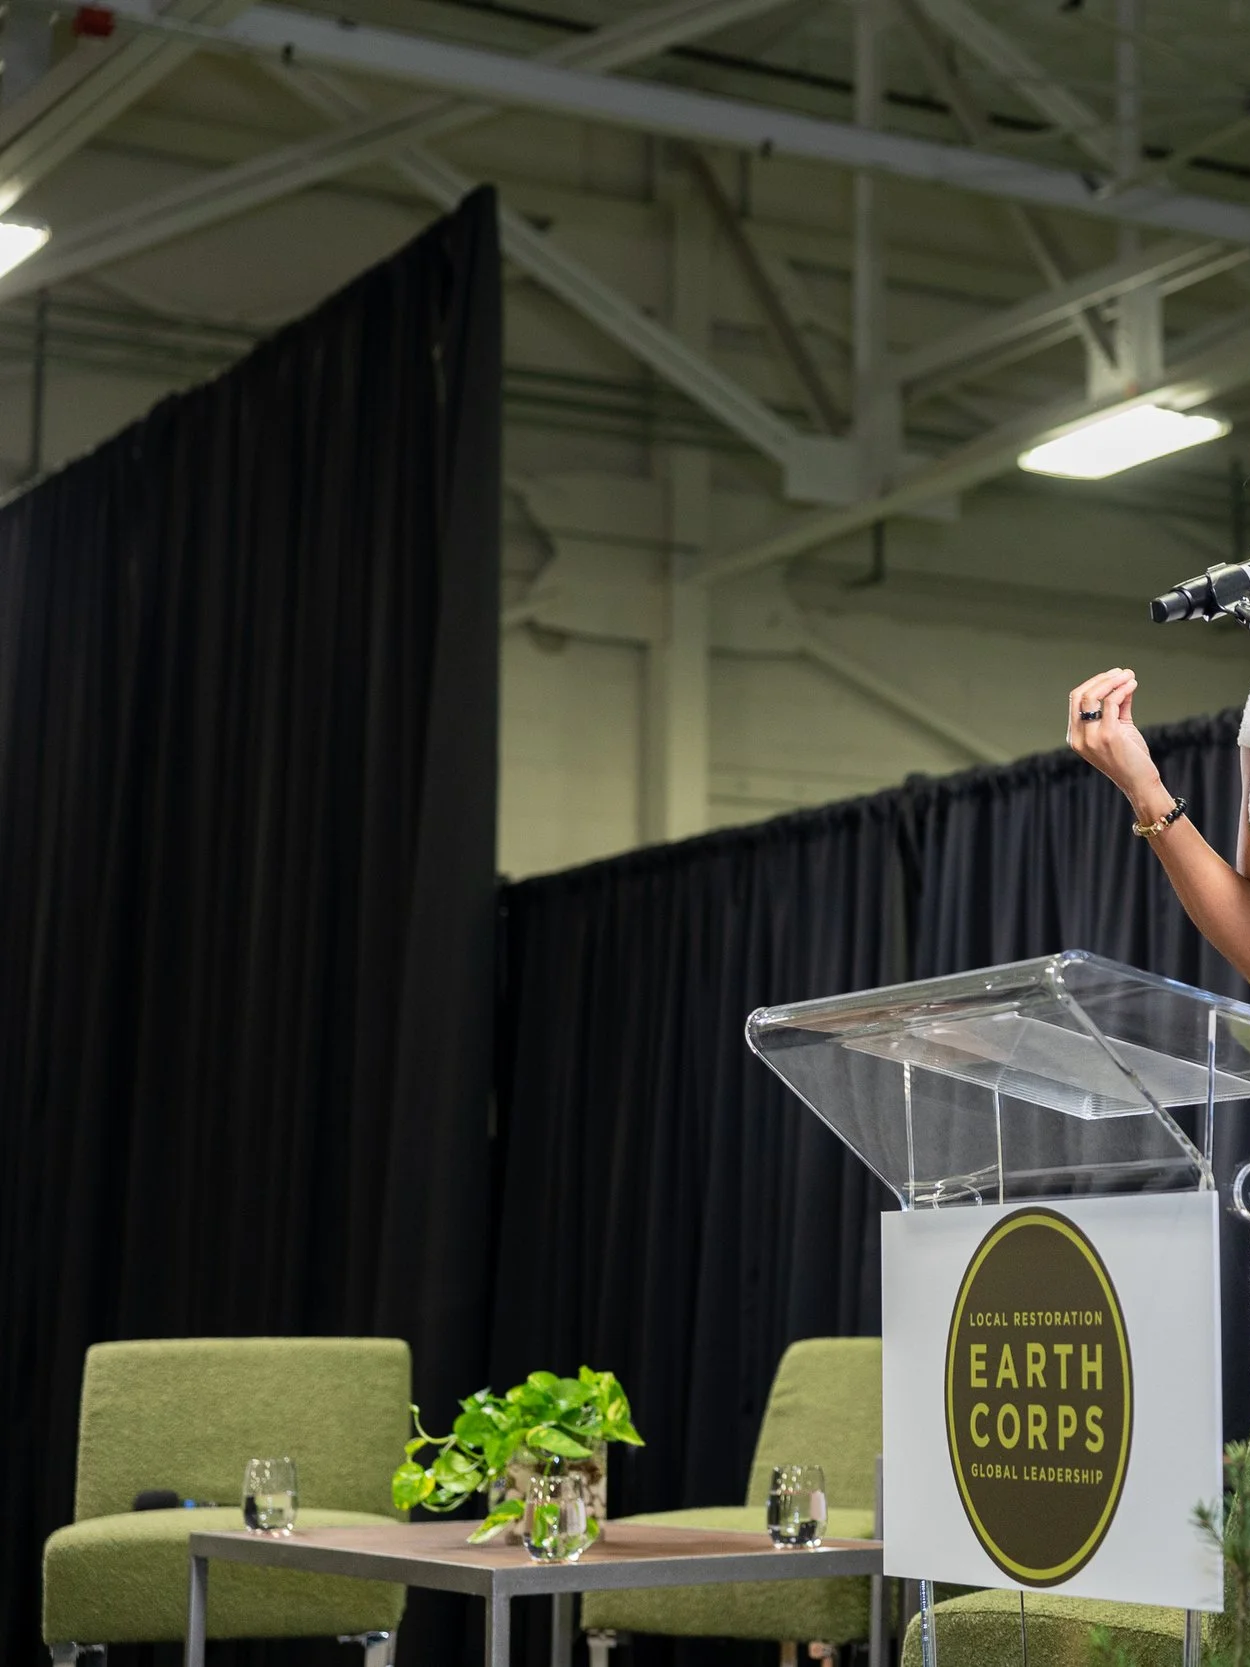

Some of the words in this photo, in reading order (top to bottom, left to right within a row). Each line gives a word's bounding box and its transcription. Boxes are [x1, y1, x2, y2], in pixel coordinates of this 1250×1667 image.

[969, 1312, 1009, 1327] LOCAL
[1013, 1310, 1103, 1327] RESTORATION
[970, 1342, 1103, 1391] EARTH
[969, 1402, 1105, 1453] CORPS
[971, 1463, 1018, 1480] GLOBAL
[1023, 1466, 1103, 1485] LEADERSHIP
